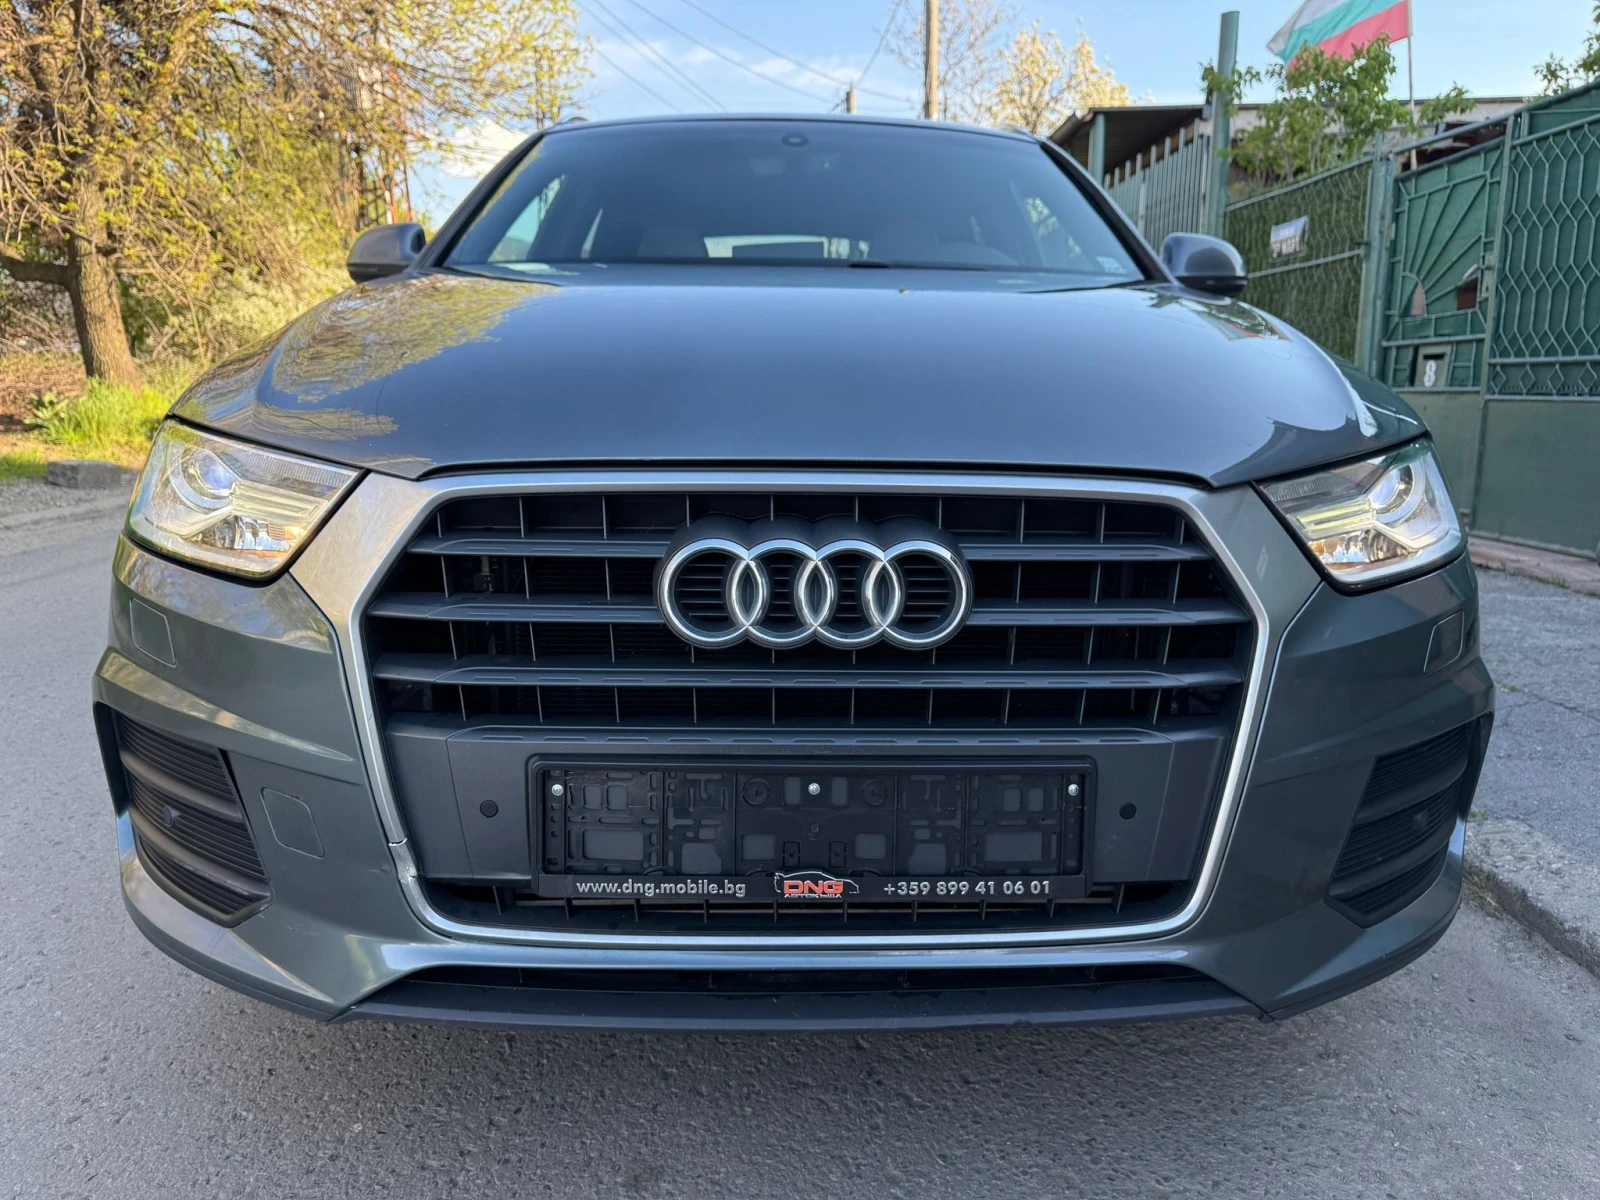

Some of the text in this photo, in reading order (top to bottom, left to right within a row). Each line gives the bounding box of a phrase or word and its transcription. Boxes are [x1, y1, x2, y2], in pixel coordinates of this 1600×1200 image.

[576, 879, 746, 897] www.dng.mobile.bg
[783, 880, 844, 894] DNG
[883, 880, 1050, 895] +359 899 41 06 01
